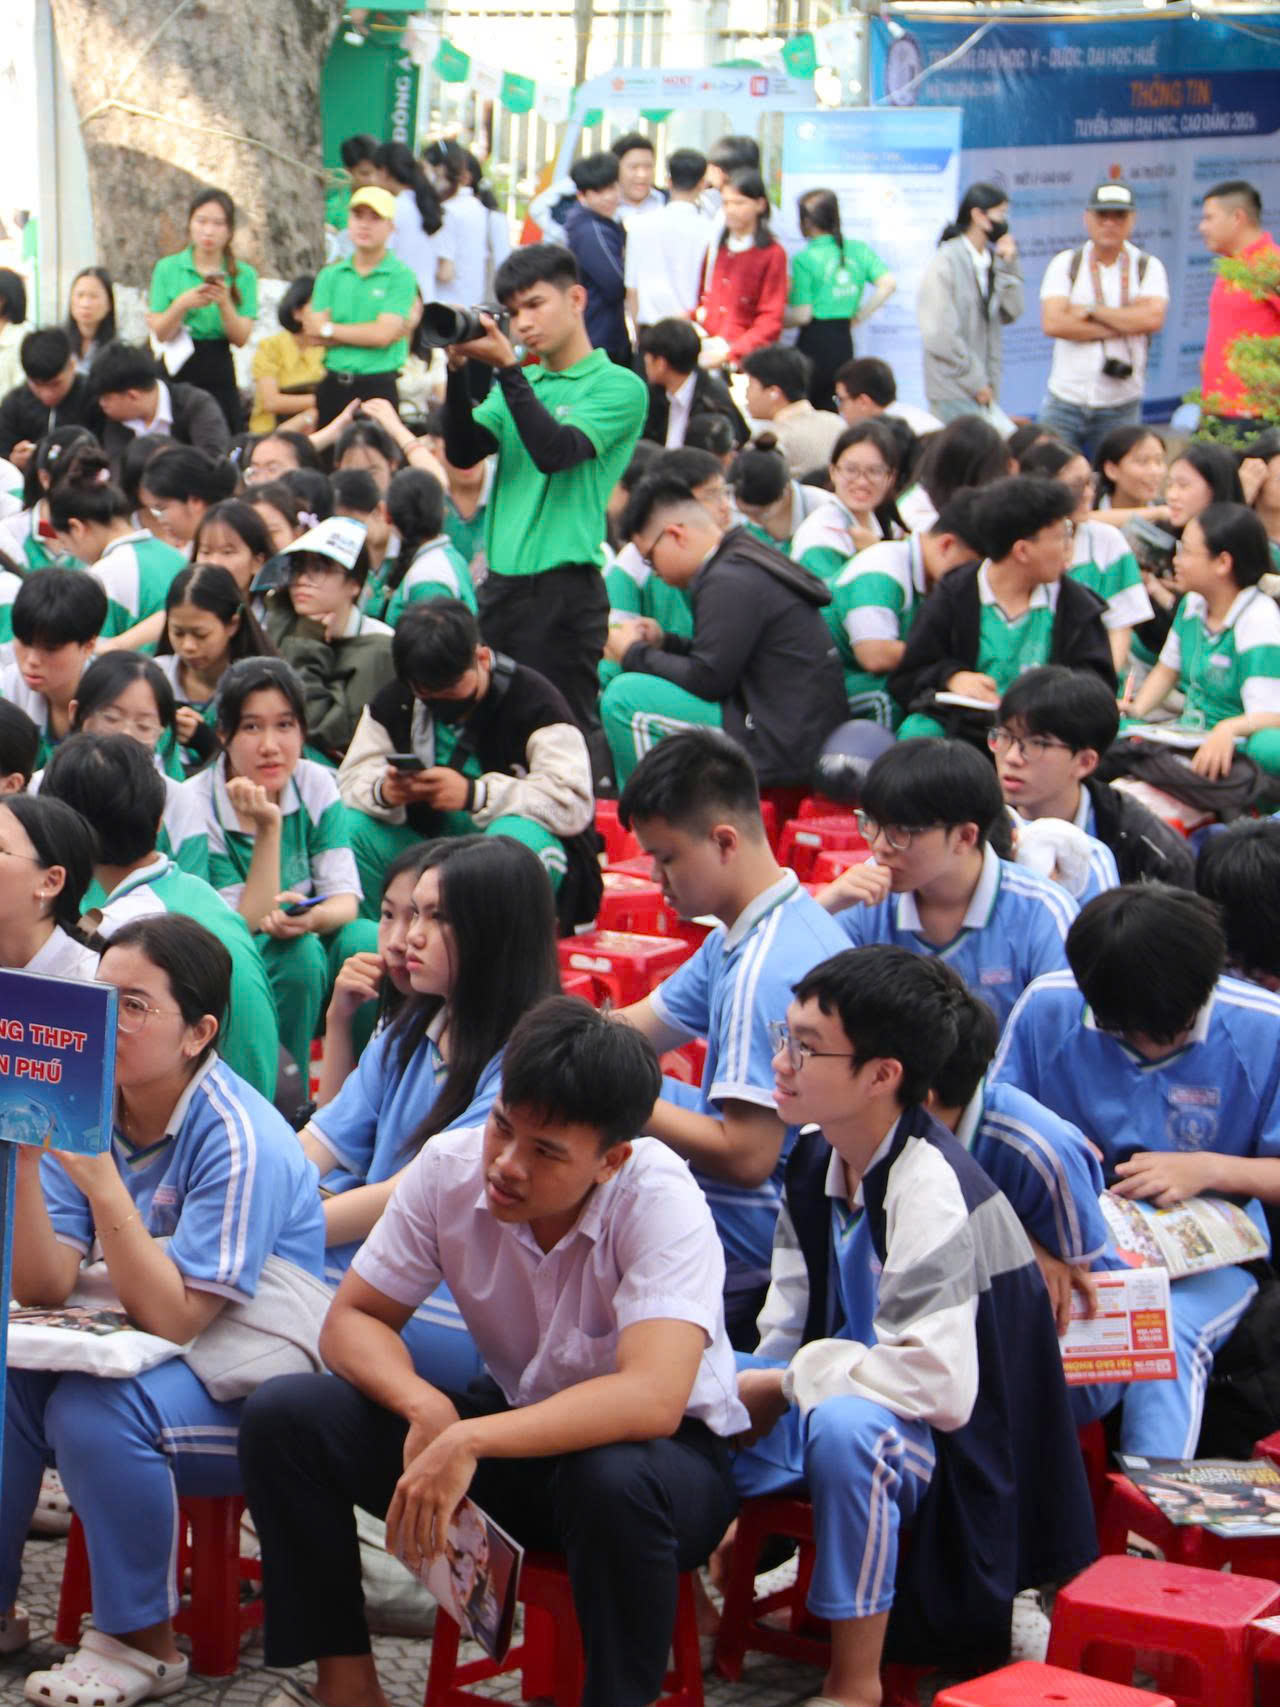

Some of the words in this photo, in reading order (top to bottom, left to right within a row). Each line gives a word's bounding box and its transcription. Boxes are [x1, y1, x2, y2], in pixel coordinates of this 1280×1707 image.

[1130, 73, 1183, 109] THÔNG
[1186, 80, 1213, 106] TIN
[29, 1023, 87, 1052] THPT
[15, 1057, 62, 1084] PHÚ
